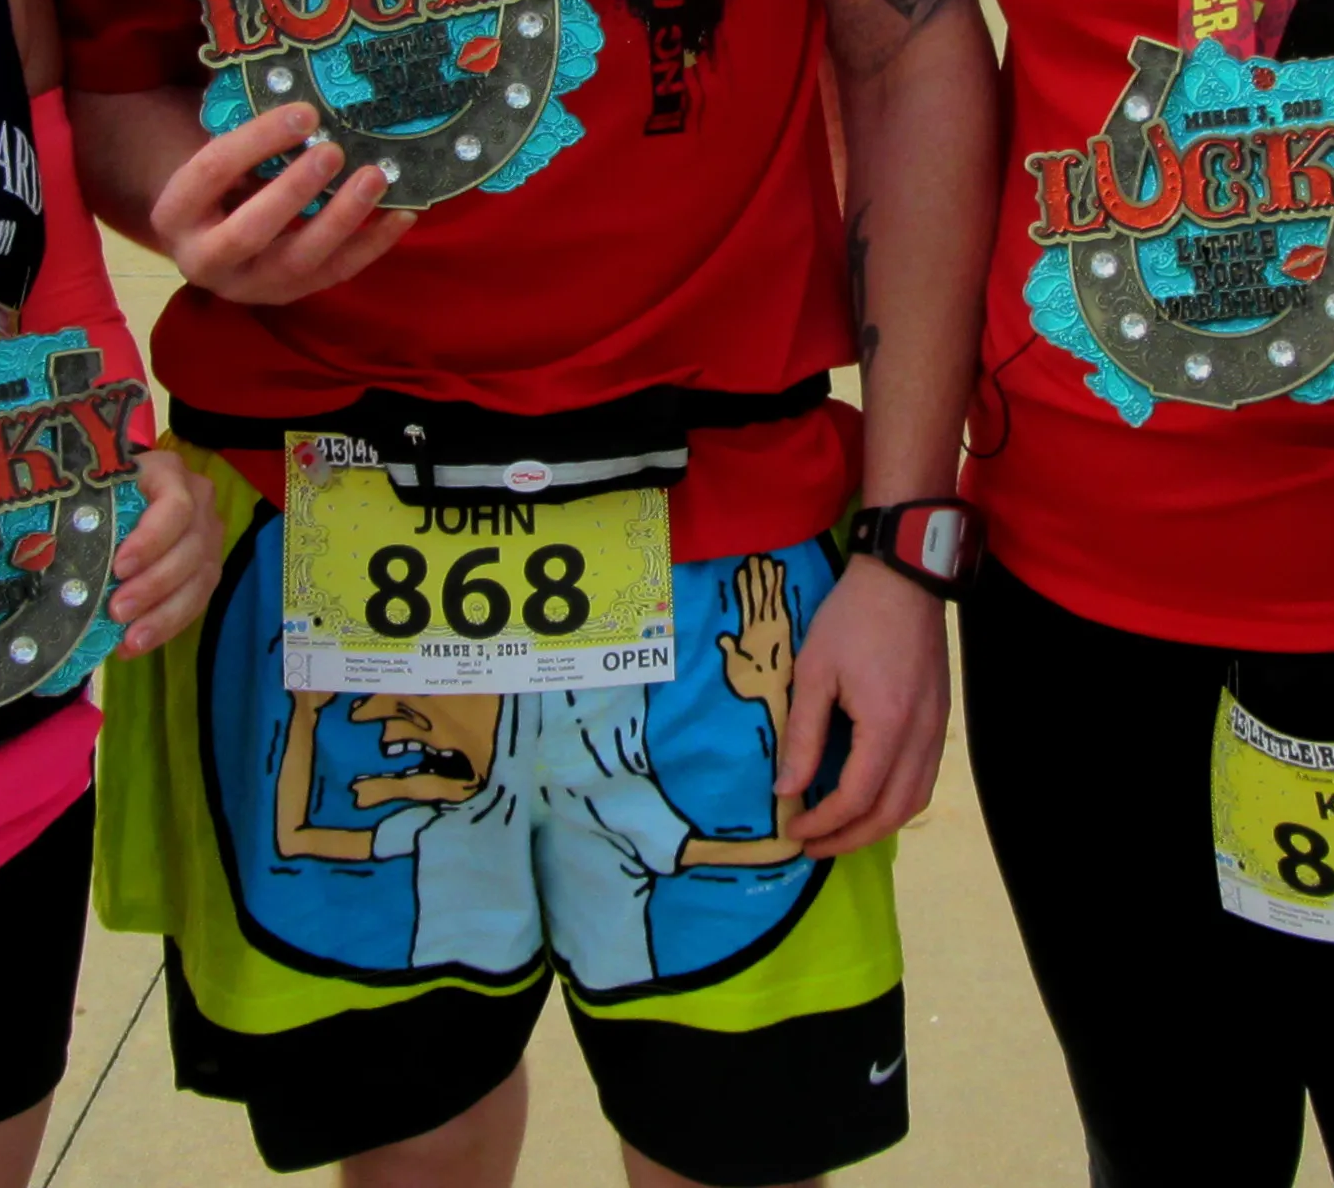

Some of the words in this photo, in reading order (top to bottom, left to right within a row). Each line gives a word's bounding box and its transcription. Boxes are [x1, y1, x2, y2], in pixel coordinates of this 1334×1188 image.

[348, 23, 451, 73] LITTLE
[1185, 109, 1251, 131] MARCH
[1283, 99, 1323, 121] 2013
[1175, 229, 1279, 266] LITTLE
[1194, 260, 1267, 290] ROCK
[1153, 284, 1314, 325] MARATHON
[414, 504, 536, 535] JOHN
[365, 543, 591, 639] 868
[421, 643, 471, 658] MARCH
[477, 644, 491, 661] 3,
[498, 643, 529, 658] 2013
[603, 646, 669, 673] OPEN
[1249, 719, 1315, 766] LITTLE
